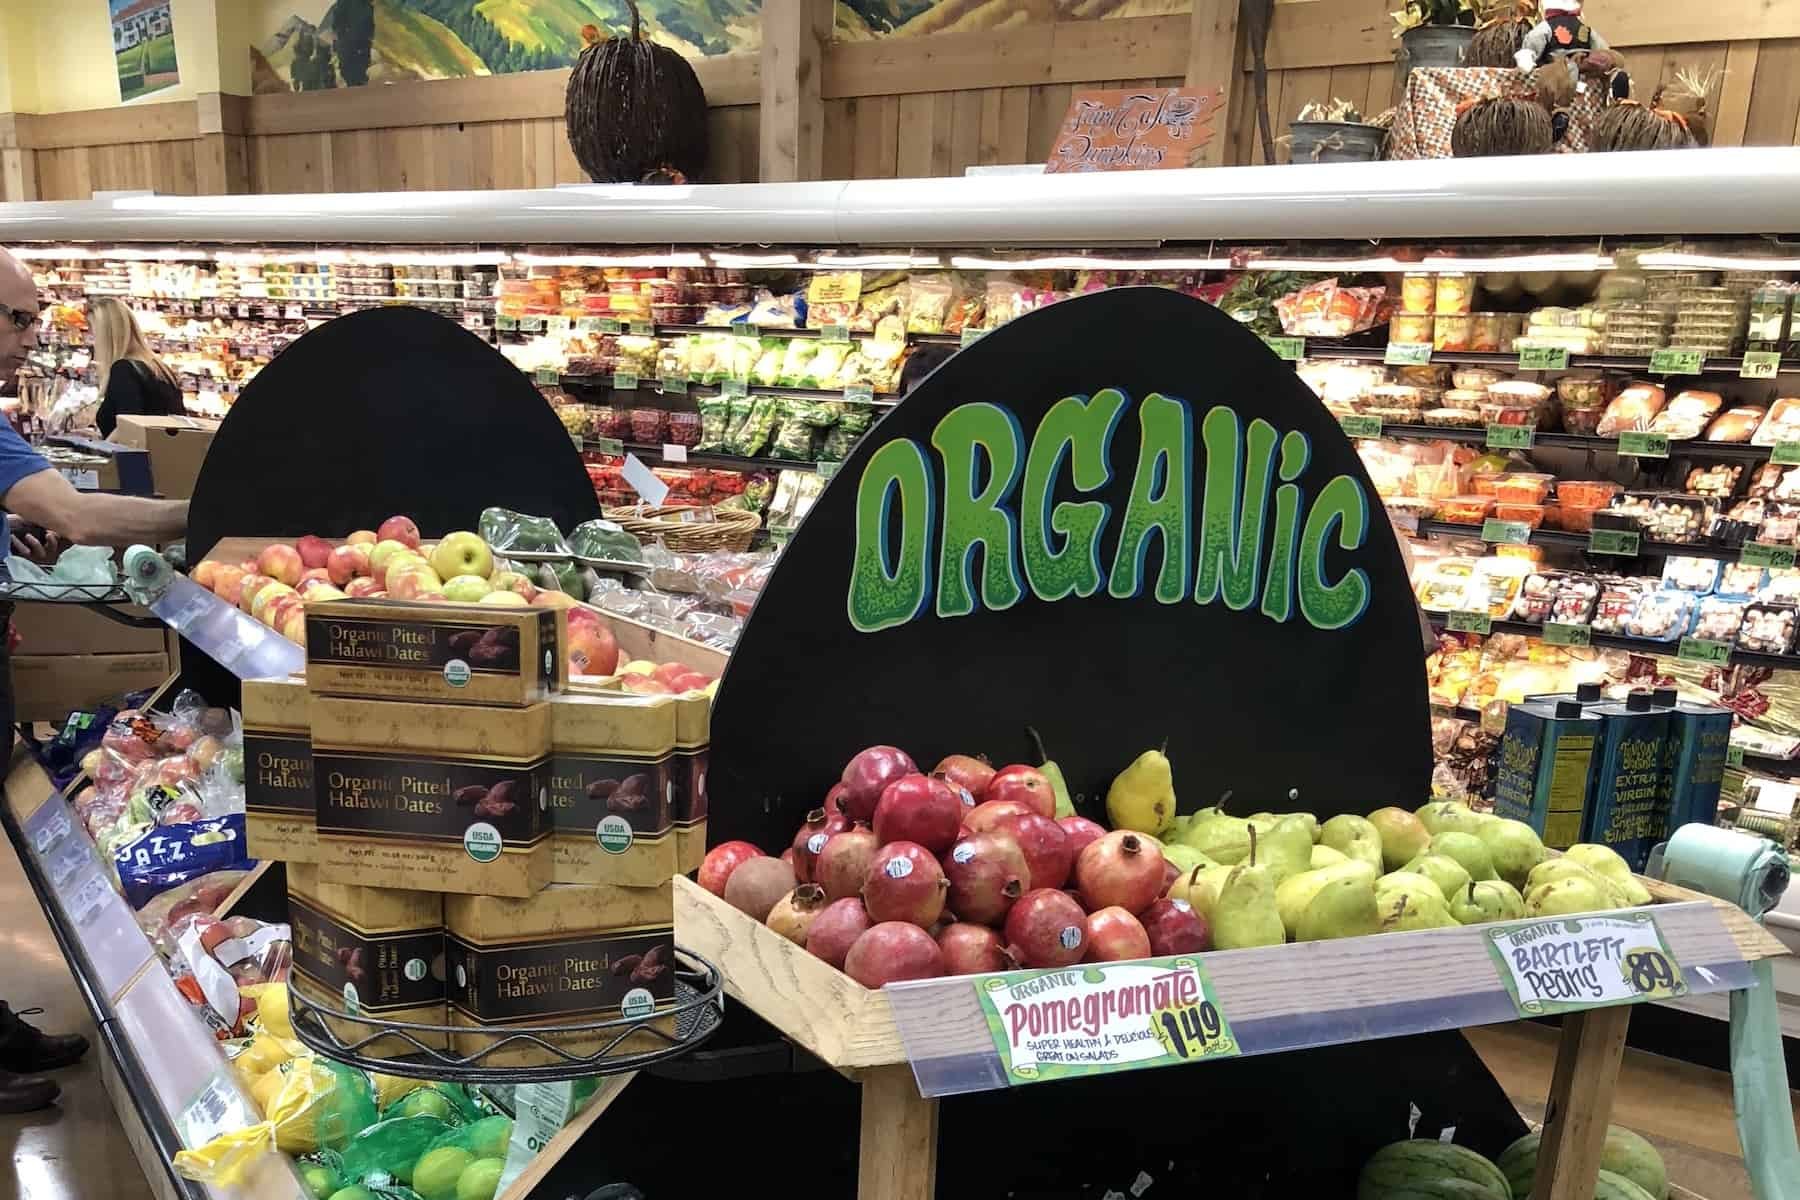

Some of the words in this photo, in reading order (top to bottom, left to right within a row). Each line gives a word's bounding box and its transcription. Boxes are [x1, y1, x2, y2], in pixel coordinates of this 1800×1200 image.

[392, 628, 436, 645] Pitted
[401, 776, 450, 795] Pitted
[1615, 773, 1657, 788] EXTRA
[328, 790, 390, 809] Halawi
[395, 794, 443, 815] Dates
[1614, 784, 1657, 802] VIRGIN
[471, 831, 495, 842] USDA
[604, 823, 625, 833] USDA
[1509, 923, 1562, 948] ORGANIC
[564, 952, 610, 975] Pitted
[1512, 937, 1625, 973] BARTLETT
[498, 978, 555, 999] Halawi
[559, 974, 602, 994] Dates
[1010, 970, 1078, 1001] ORGANIC
[1004, 970, 1199, 1048] Pomegranate
[1026, 1037, 1060, 1051] SUPER
